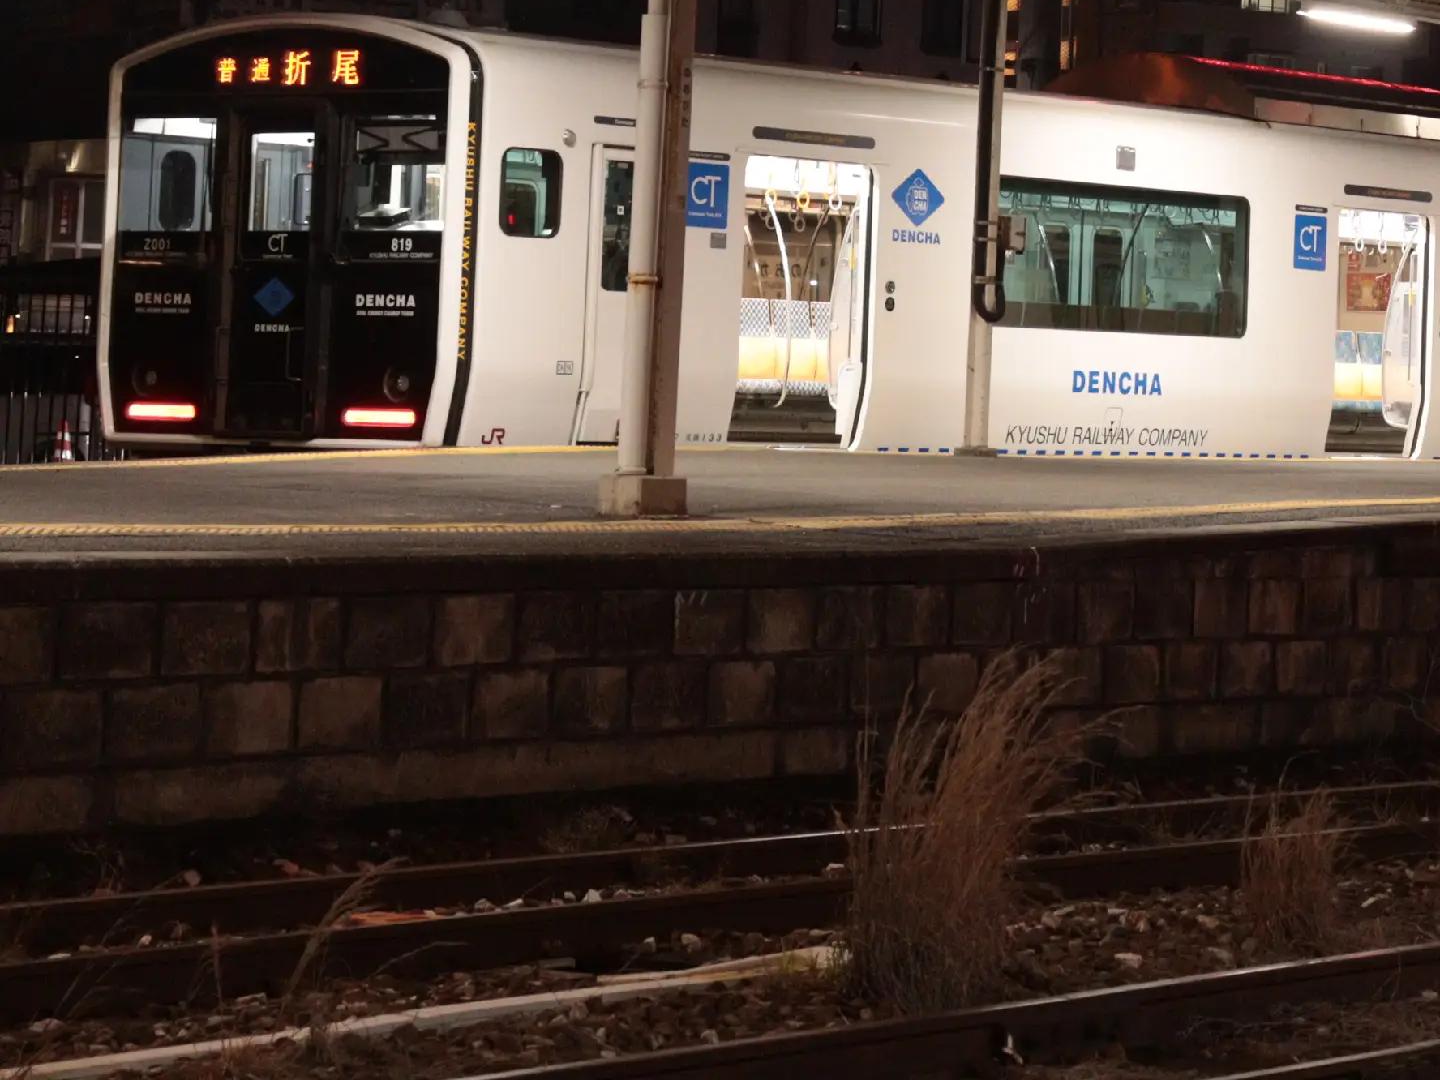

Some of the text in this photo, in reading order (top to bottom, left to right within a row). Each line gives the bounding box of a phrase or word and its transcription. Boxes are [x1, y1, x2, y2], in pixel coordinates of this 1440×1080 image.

[691, 174, 722, 209] CT
[267, 233, 289, 253] CT
[391, 237, 413, 252] 819
[892, 229, 942, 245] DENCHA
[1299, 224, 1323, 253] CT
[134, 291, 192, 305] DENCHA
[356, 293, 416, 307] DENCHA
[254, 323, 291, 333] DENCHA
[1072, 370, 1163, 396] DENCHA
[481, 427, 505, 445] JR
[1004, 423, 1209, 447] KYUSHU RAILWAY COMPANY
